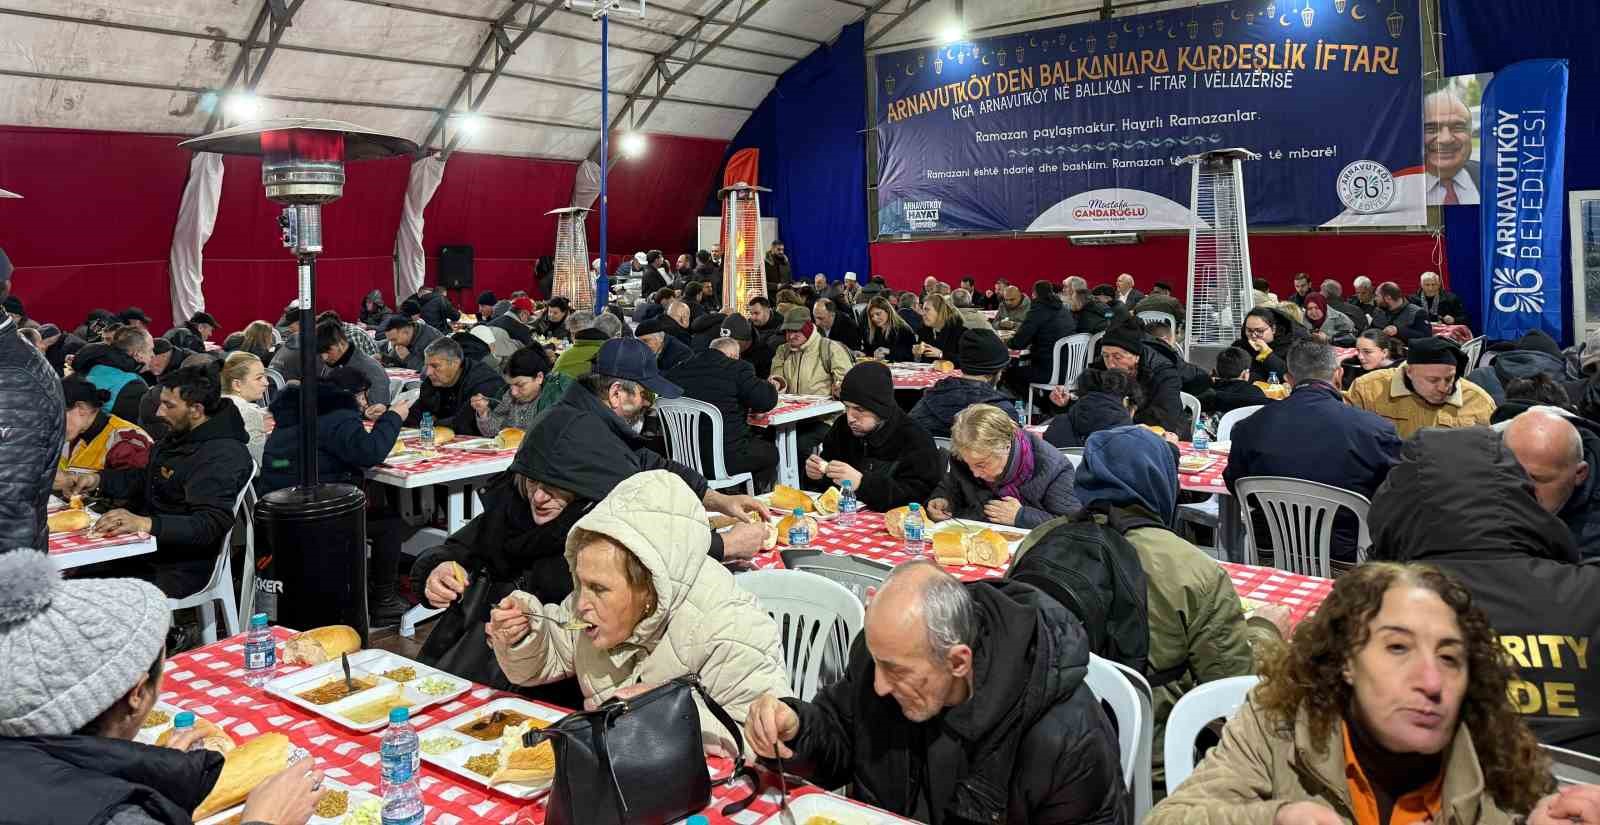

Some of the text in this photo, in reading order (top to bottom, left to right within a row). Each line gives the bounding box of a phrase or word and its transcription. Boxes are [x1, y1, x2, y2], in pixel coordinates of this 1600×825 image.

[887, 38, 1399, 123] ARNAVUTKÖY'DEN BALKANLARA KARDEŞLİK İFTARI
[952, 106, 974, 120] NGA
[979, 88, 1048, 115] ARNAVUTKÖY
[1054, 84, 1070, 101] NË
[1075, 79, 1131, 98] BALLKAN
[1150, 74, 1187, 91] IFTAR
[976, 109, 1261, 143] Ramazan paylaşmaktır. Hayırlı Ramazanlar.
[927, 168, 970, 180] Ramazani
[1038, 163, 1058, 173] dhe
[1062, 160, 1108, 172] bashkim.
[1112, 156, 1164, 169] Ramazan
[1269, 150, 1282, 160] të
[1289, 145, 1337, 159] mbarë!
[1341, 163, 1392, 185] ARNAVUTKÖY
[1492, 110, 1520, 258] ARNAVUTKÖY
[1520, 109, 1546, 260] BELEDİYESİ
[908, 210, 938, 219] HAYAT
[1075, 207, 1145, 218] CANDAROĞLU
[1088, 199, 1129, 210] Mustafa
[1500, 634, 1590, 669] RITY
